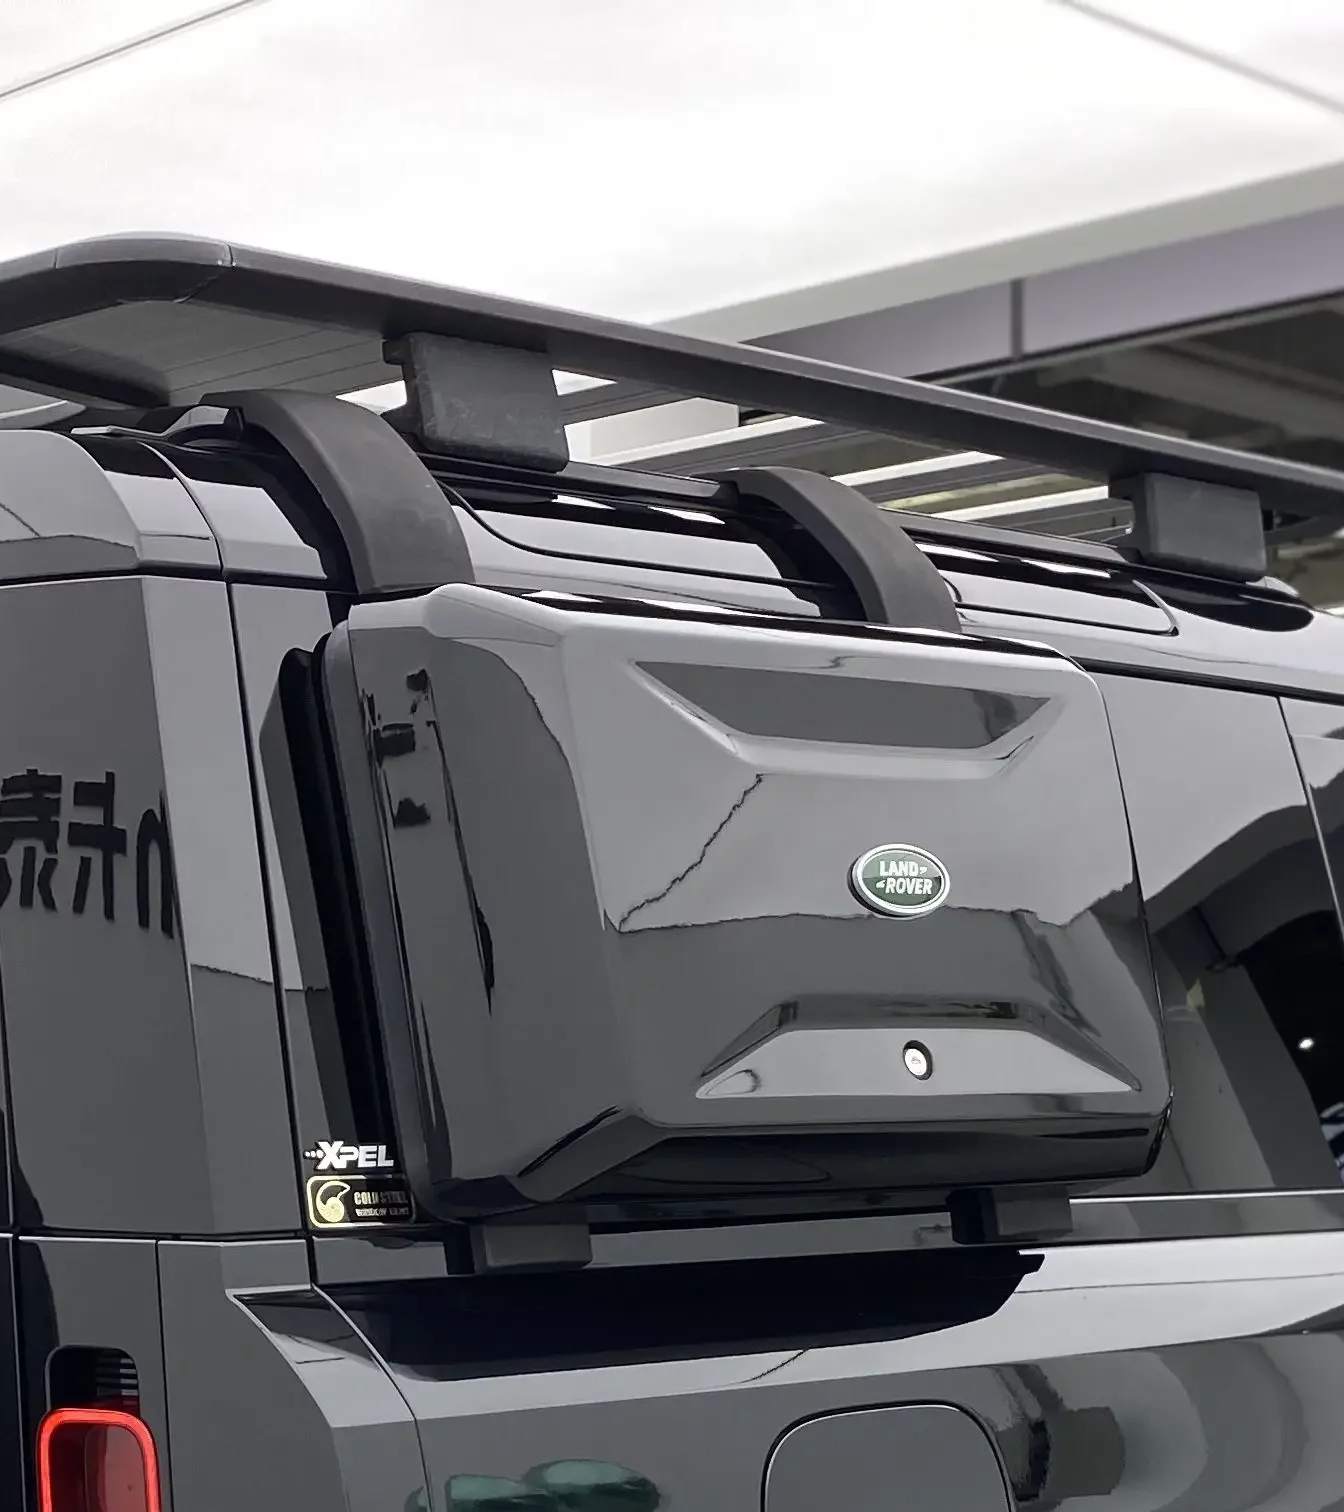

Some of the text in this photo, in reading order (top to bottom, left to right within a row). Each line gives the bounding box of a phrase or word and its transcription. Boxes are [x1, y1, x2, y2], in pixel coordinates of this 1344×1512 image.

[879, 860, 919, 877] LAND
[885, 877, 933, 895] ROVER
[316, 1140, 394, 1170] XPEL
